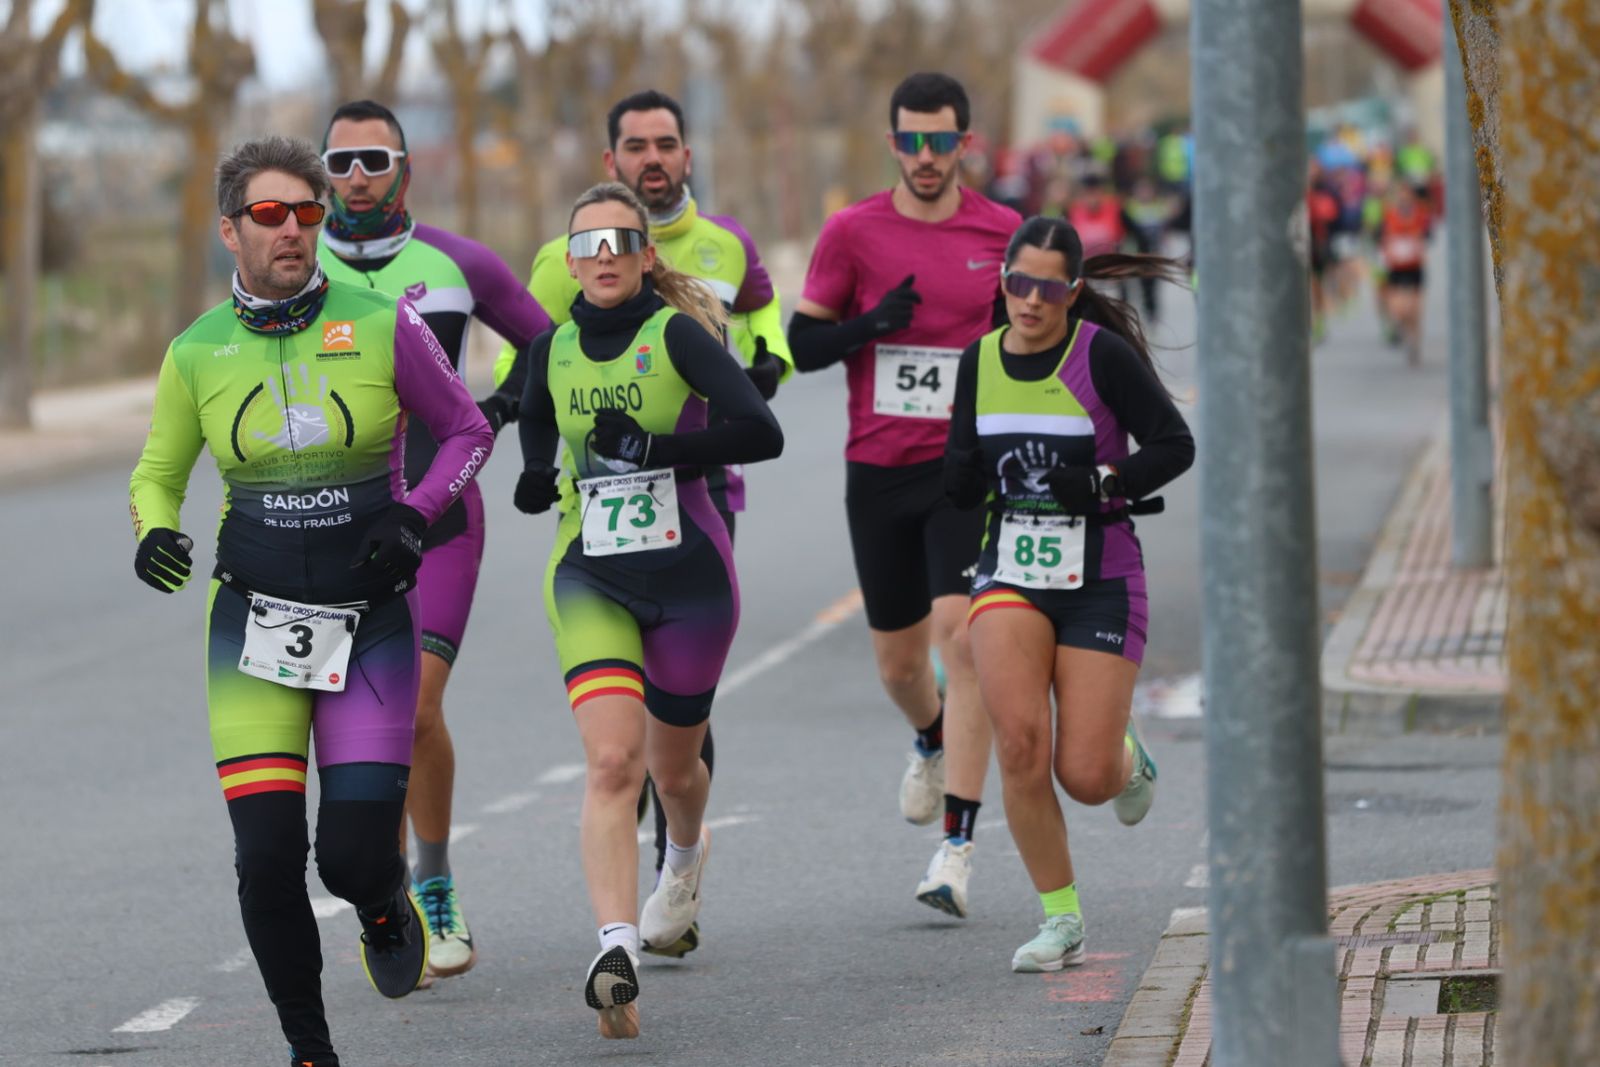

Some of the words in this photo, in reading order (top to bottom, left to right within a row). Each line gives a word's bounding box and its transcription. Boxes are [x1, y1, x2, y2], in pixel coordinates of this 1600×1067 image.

[896, 364, 942, 393] 54
[569, 381, 643, 416] ALONSO
[251, 456, 279, 469] CLUB
[613, 477, 632, 487] CROSS
[262, 487, 350, 511] SARDÓN
[280, 519, 302, 529] LOS
[303, 513, 353, 530] FRAILES
[601, 494, 656, 532] 73
[1014, 534, 1062, 568] 85
[263, 600, 291, 613] DUATLÓN
[292, 606, 316, 617] CROSS
[285, 624, 314, 659] 3
